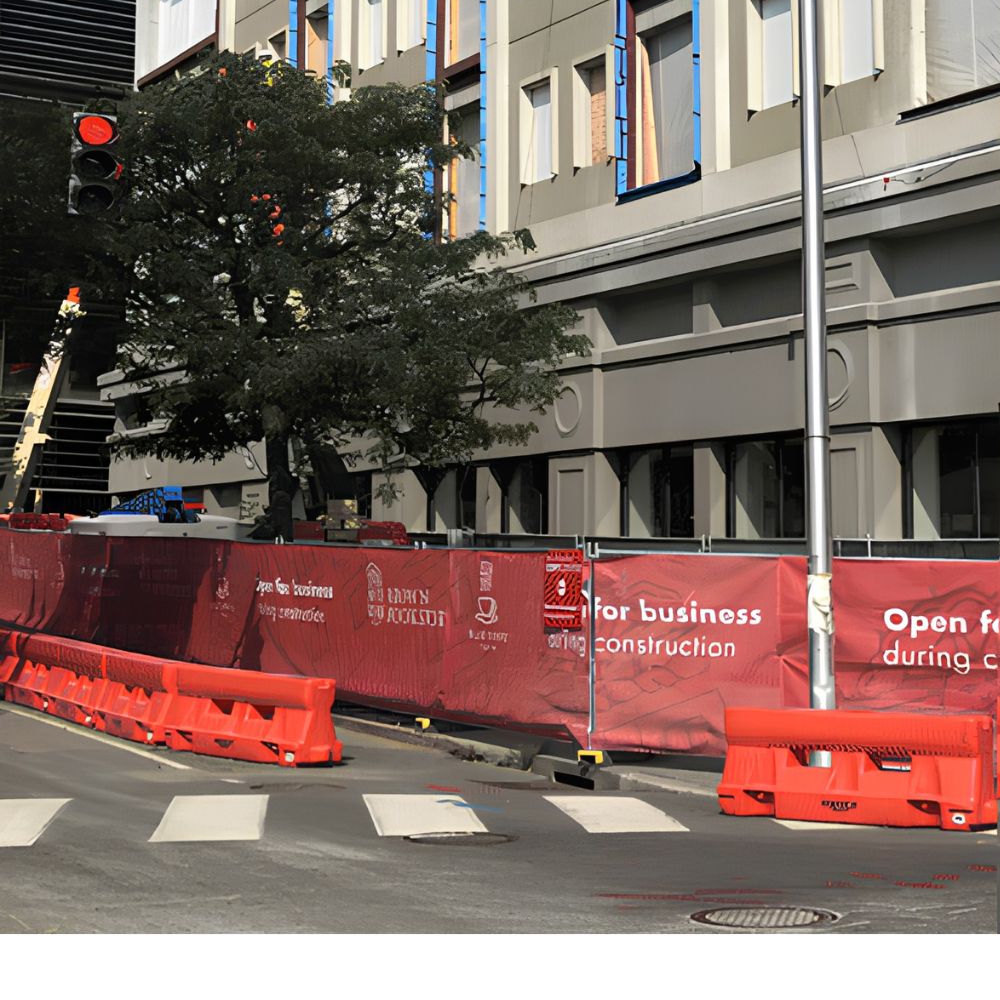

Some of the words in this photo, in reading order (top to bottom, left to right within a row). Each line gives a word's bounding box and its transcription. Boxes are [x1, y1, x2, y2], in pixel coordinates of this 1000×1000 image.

[639, 598, 763, 625] business
[883, 607, 968, 638] Open
[594, 634, 736, 658] construction
[882, 639, 971, 675] during
